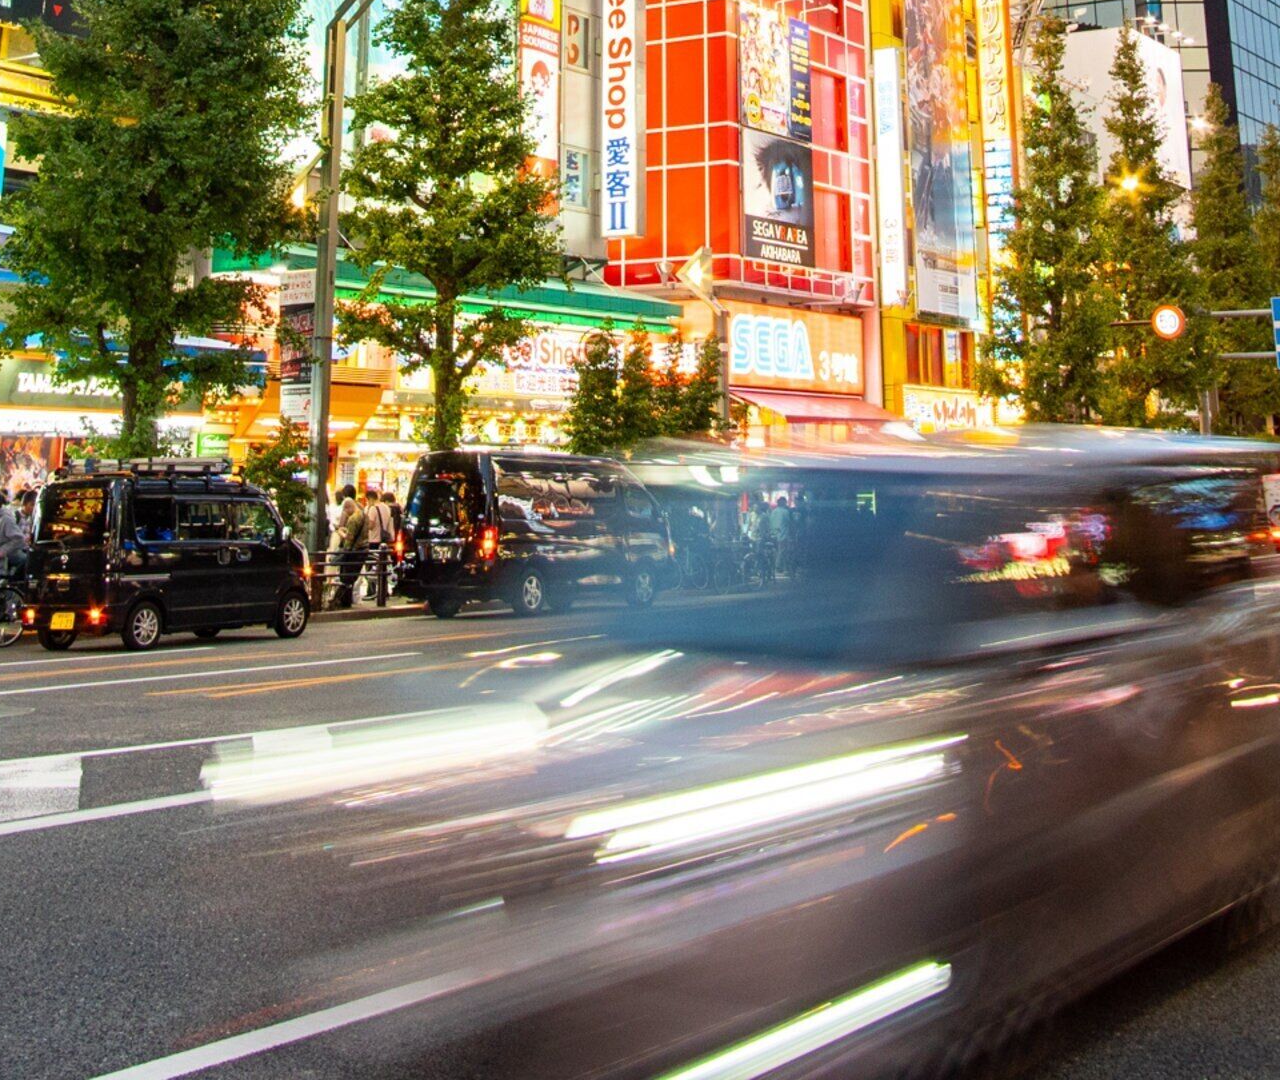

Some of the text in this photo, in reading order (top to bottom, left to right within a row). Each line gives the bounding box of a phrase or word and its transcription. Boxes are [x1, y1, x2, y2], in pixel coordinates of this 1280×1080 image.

[605, 36, 632, 130] Shop
[752, 219, 775, 237] SEGA
[760, 243, 802, 265] AKIHABARA
[730, 313, 815, 381] SEGA
